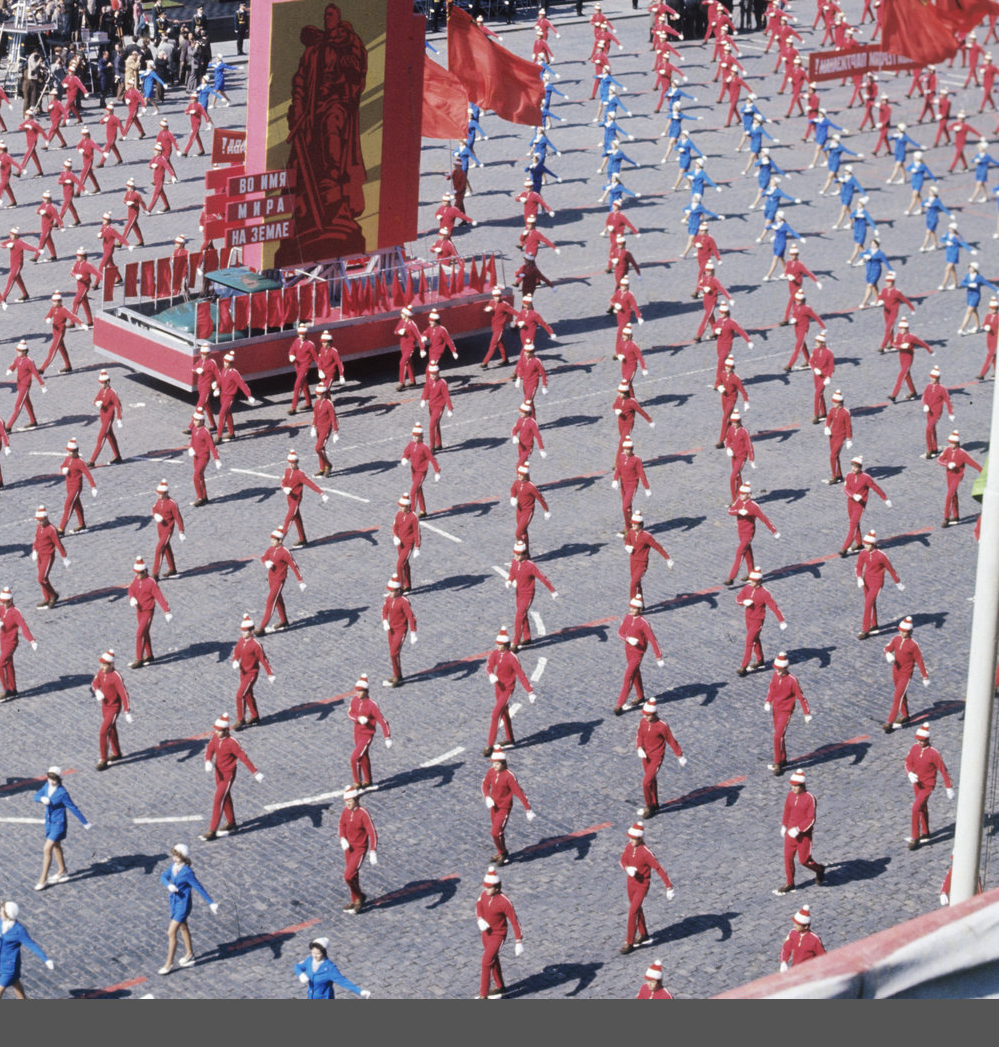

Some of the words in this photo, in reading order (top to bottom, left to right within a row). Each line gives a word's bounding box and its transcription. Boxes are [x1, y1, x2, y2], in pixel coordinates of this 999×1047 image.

[239, 177, 254, 194] ВО
[261, 172, 287, 190] ИМЯ
[238, 197, 284, 219] МИРА
[232, 229, 246, 245] НА
[251, 222, 289, 242] ЗЕМЛЕ
